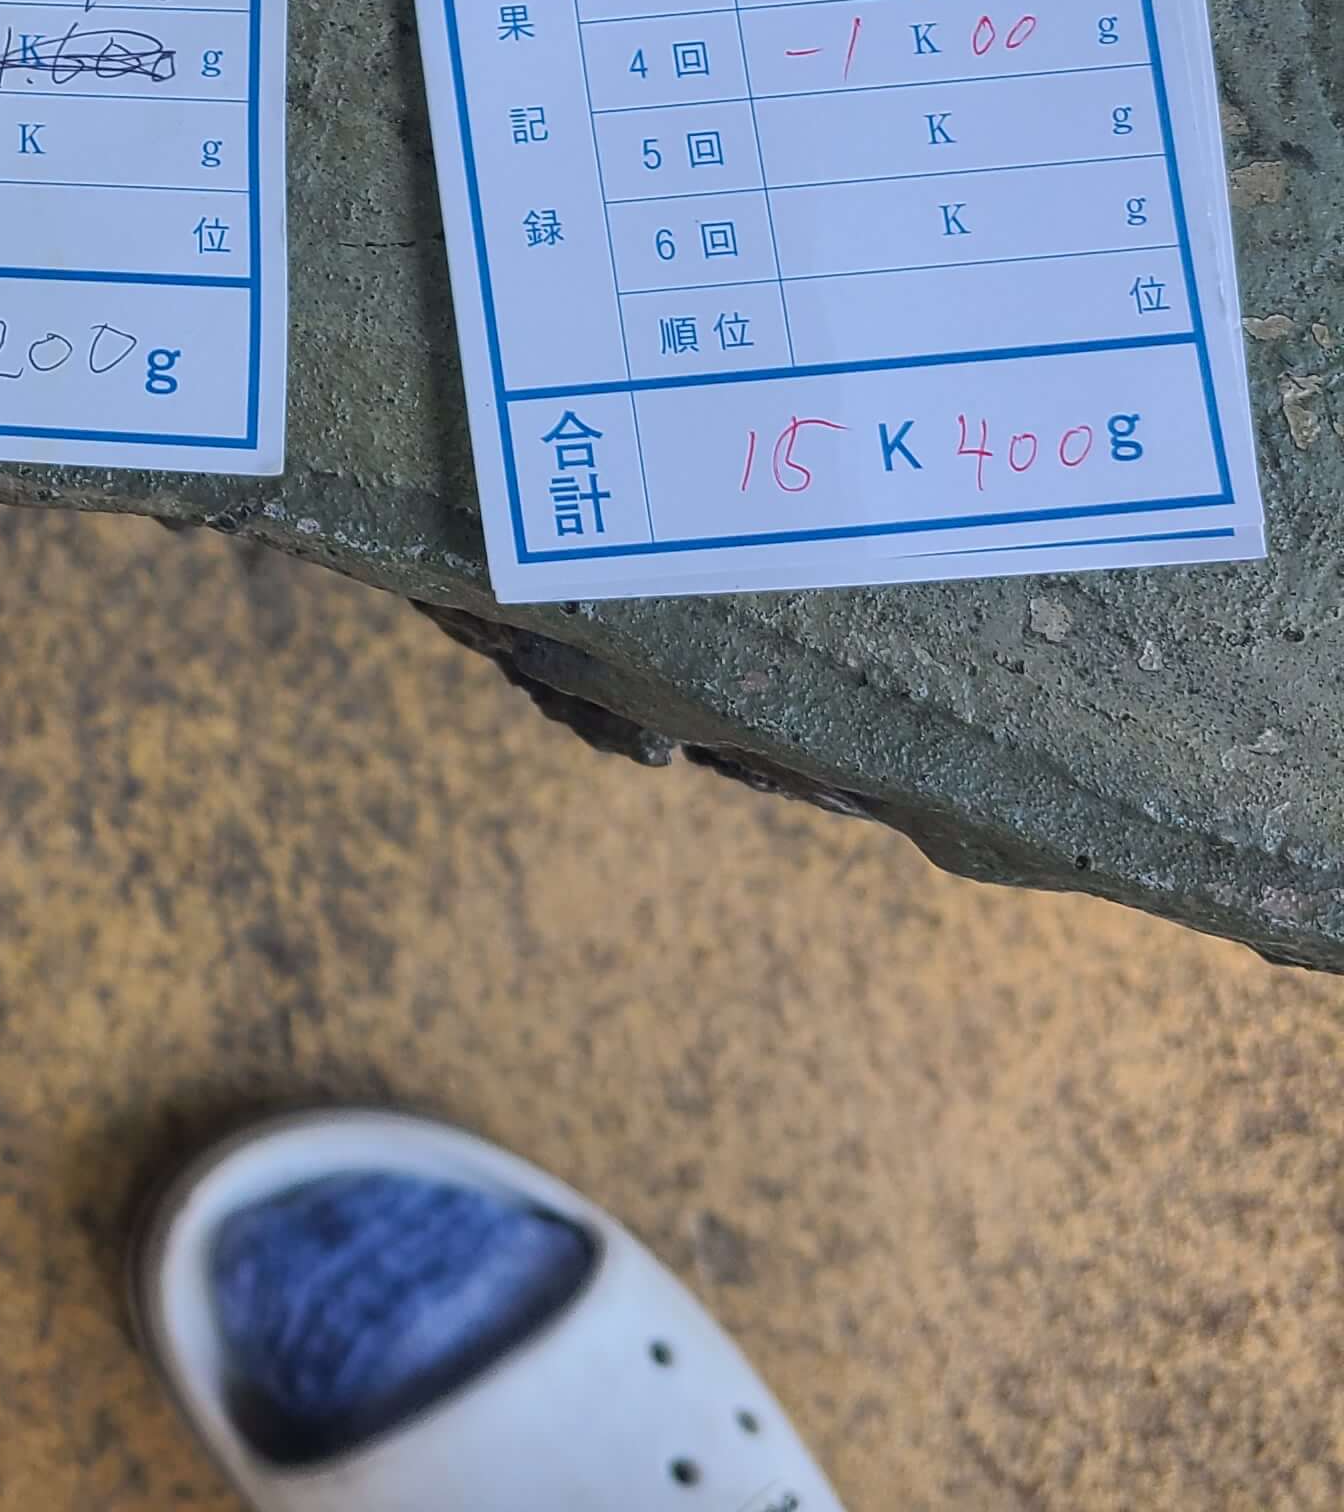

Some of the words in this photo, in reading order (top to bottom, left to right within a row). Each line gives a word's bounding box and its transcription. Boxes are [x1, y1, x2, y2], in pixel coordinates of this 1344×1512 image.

[629, 41, 710, 79] 4回
[643, 131, 725, 170] 5回
[192, 216, 231, 254] 位
[655, 221, 739, 261] 6回
[1129, 275, 1171, 315] 位
[659, 311, 755, 355] 順位
[145, 348, 181, 395] g
[879, 420, 923, 472] K
[956, 414, 1092, 492] 400
[1107, 413, 1144, 462] g
[541, 410, 612, 537] 合計
